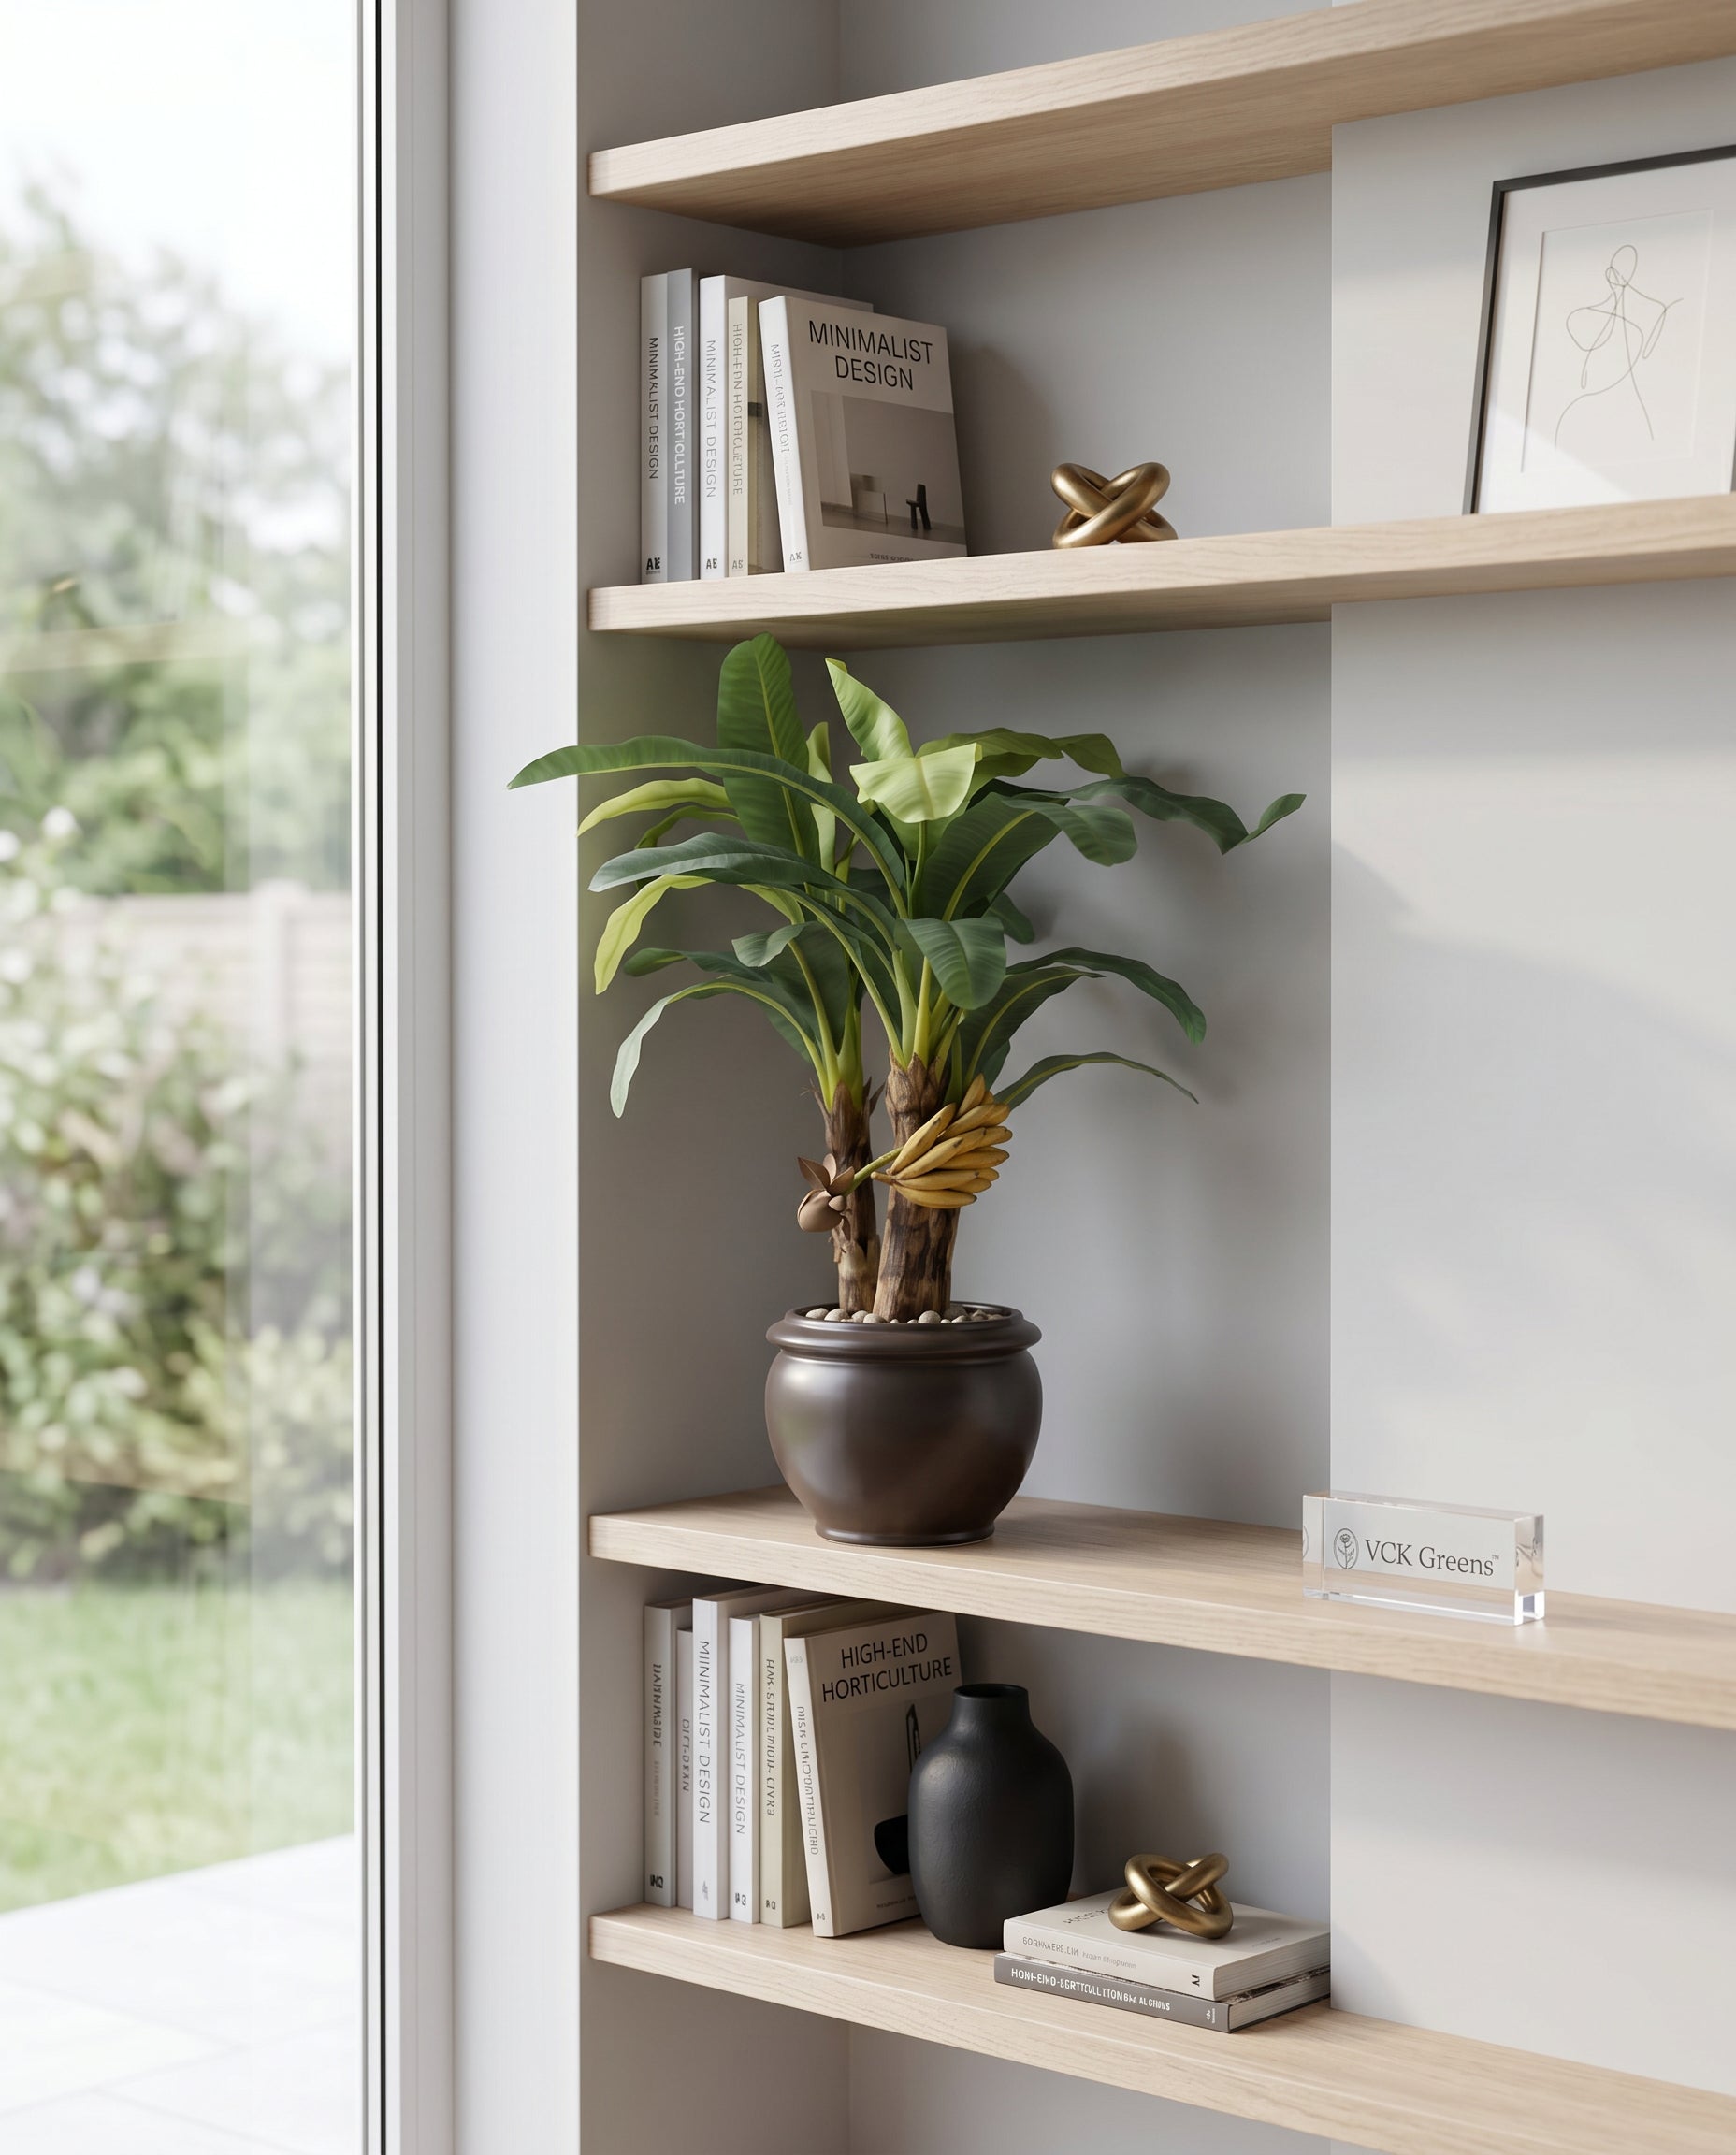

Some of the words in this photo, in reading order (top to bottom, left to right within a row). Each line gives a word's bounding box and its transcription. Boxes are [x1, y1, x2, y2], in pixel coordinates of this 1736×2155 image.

[673, 325, 686, 398] HIGH-END
[808, 320, 933, 364] MINIMALIST
[706, 340, 716, 429] MINIMALIST
[834, 355, 914, 390] DESIGN
[648, 426, 659, 480] DESIGN
[706, 436, 716, 499] DESIGN
[1364, 1539, 1413, 1567] VCK
[822, 1656, 953, 1702] HORTICULTURE
[841, 1633, 928, 1669] HIGH-END
[735, 1683, 745, 1771] MINIMALIST
[699, 1754, 711, 1824] DESIGN
[735, 1774, 745, 1835] DESIGN
